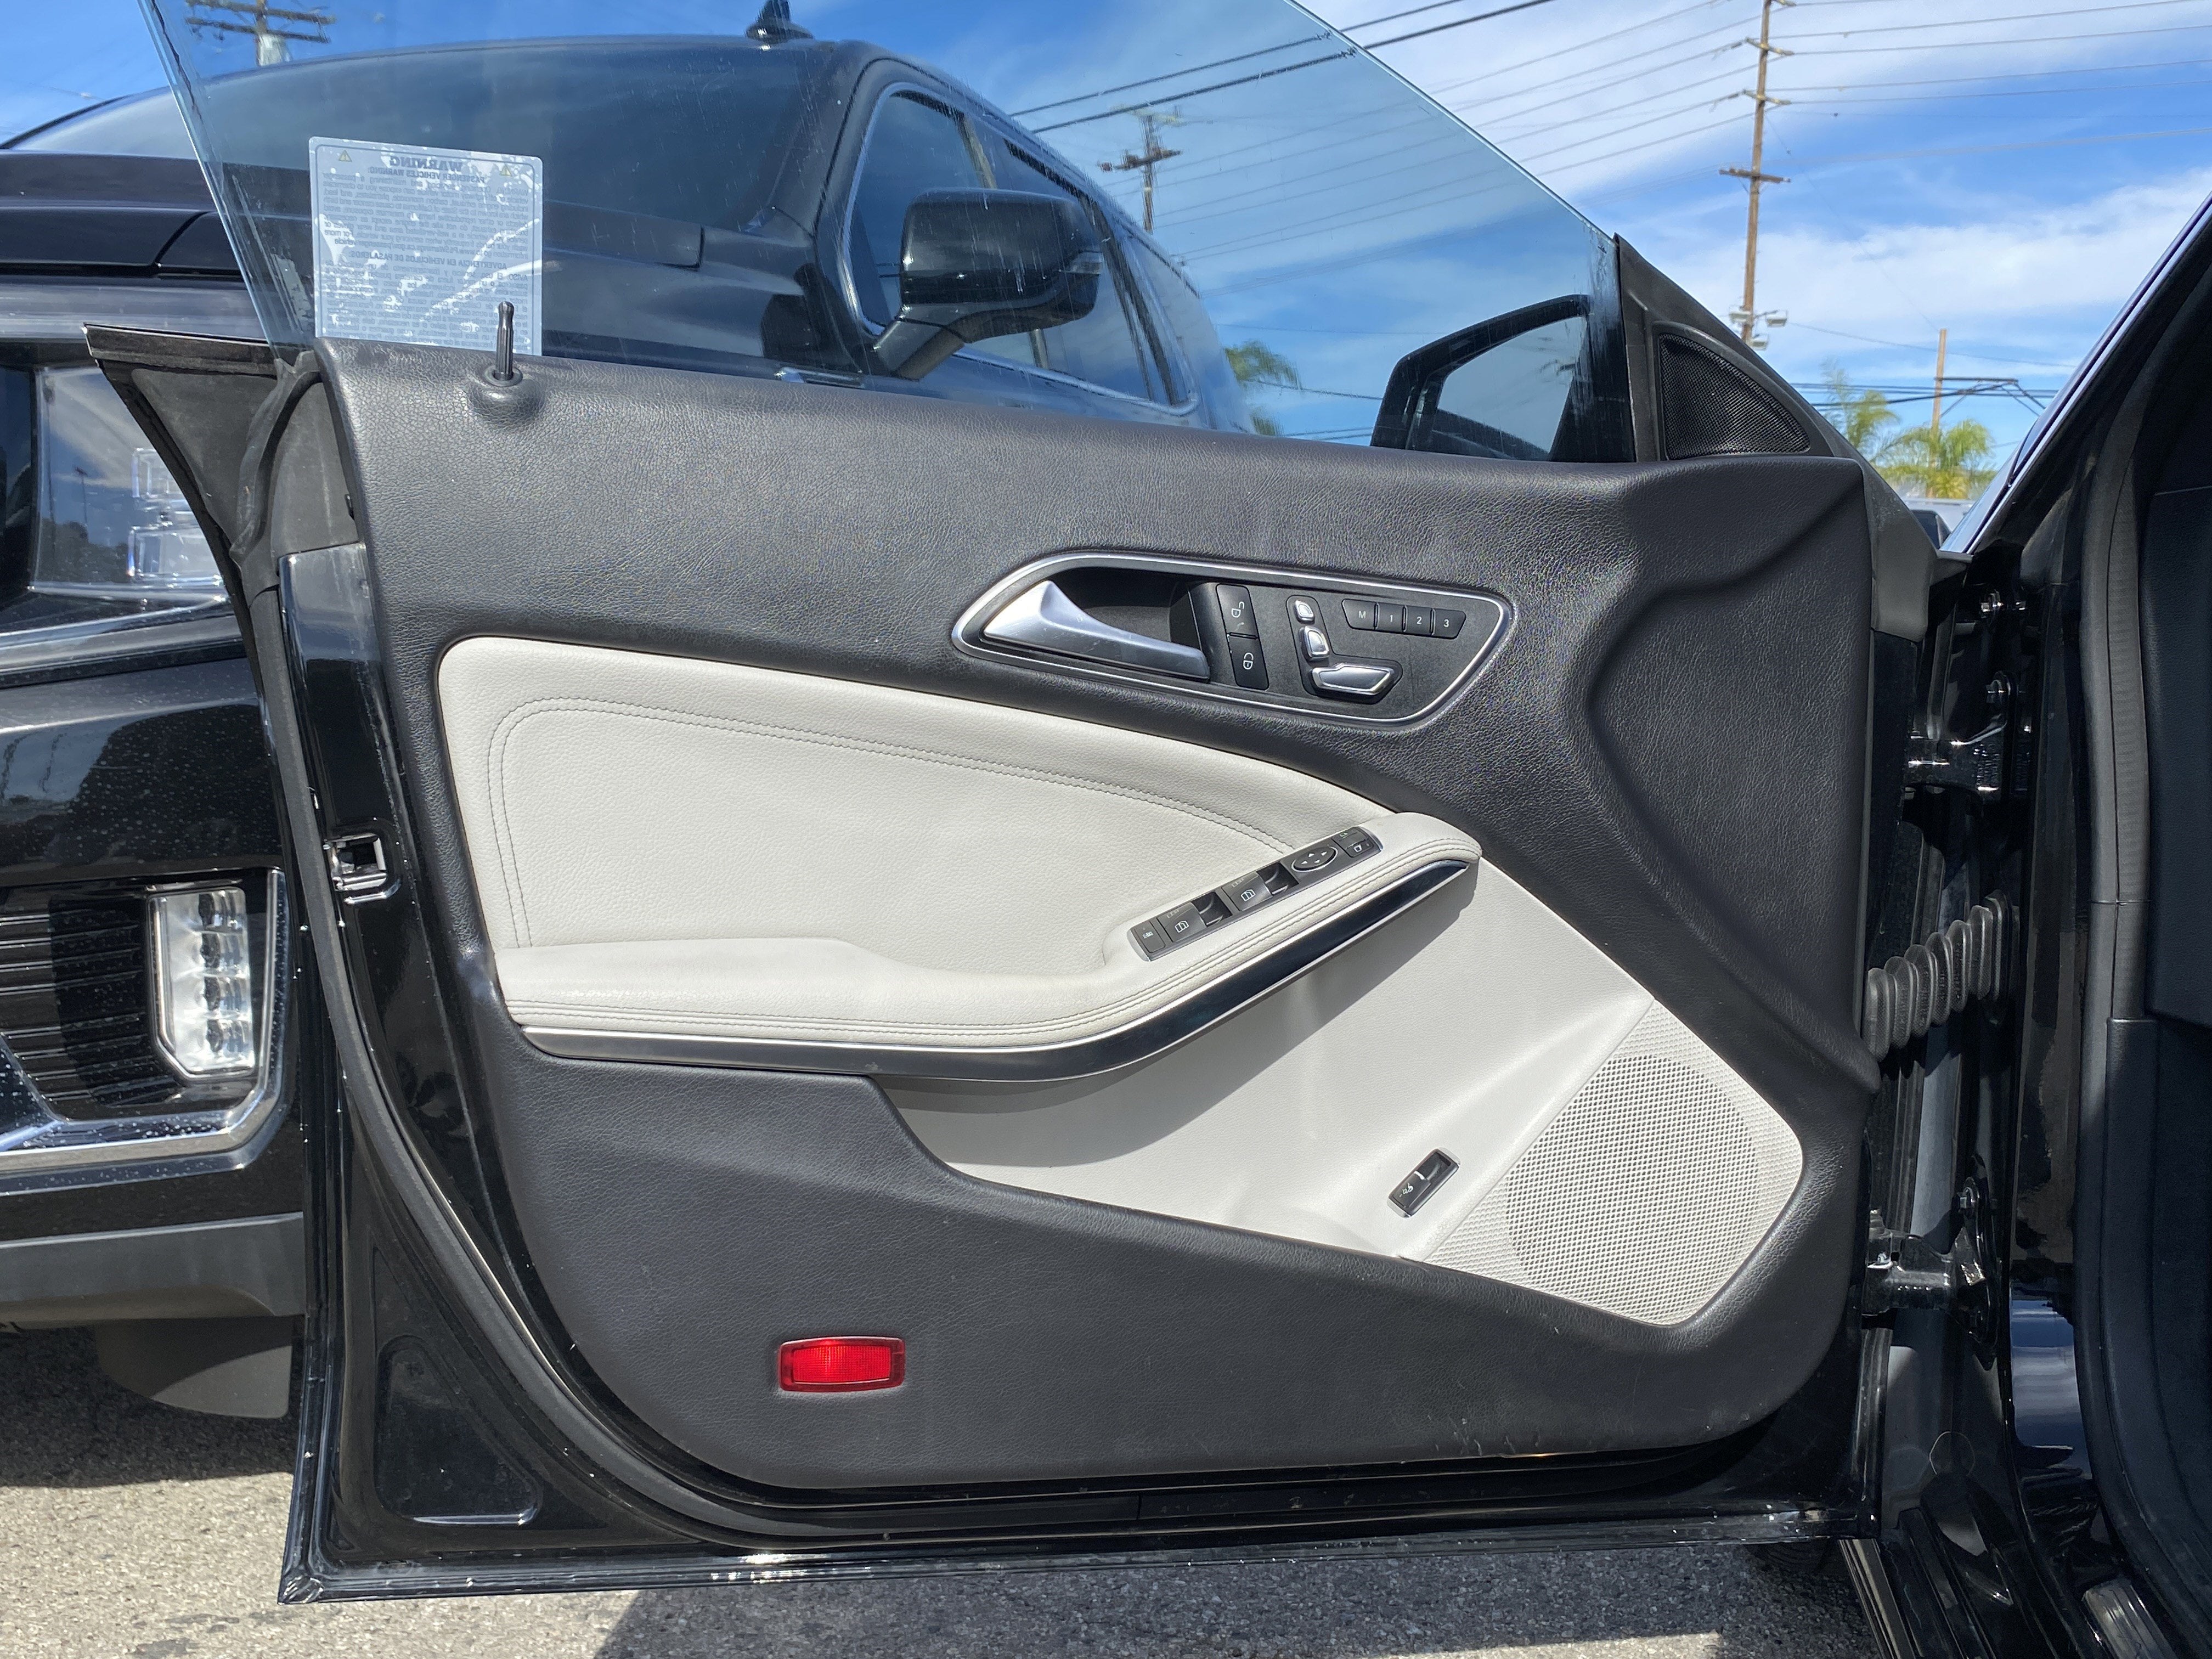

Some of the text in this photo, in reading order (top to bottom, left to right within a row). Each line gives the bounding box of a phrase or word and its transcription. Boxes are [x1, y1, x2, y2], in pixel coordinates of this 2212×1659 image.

[1358, 611, 1449, 628] M 1 2 3
